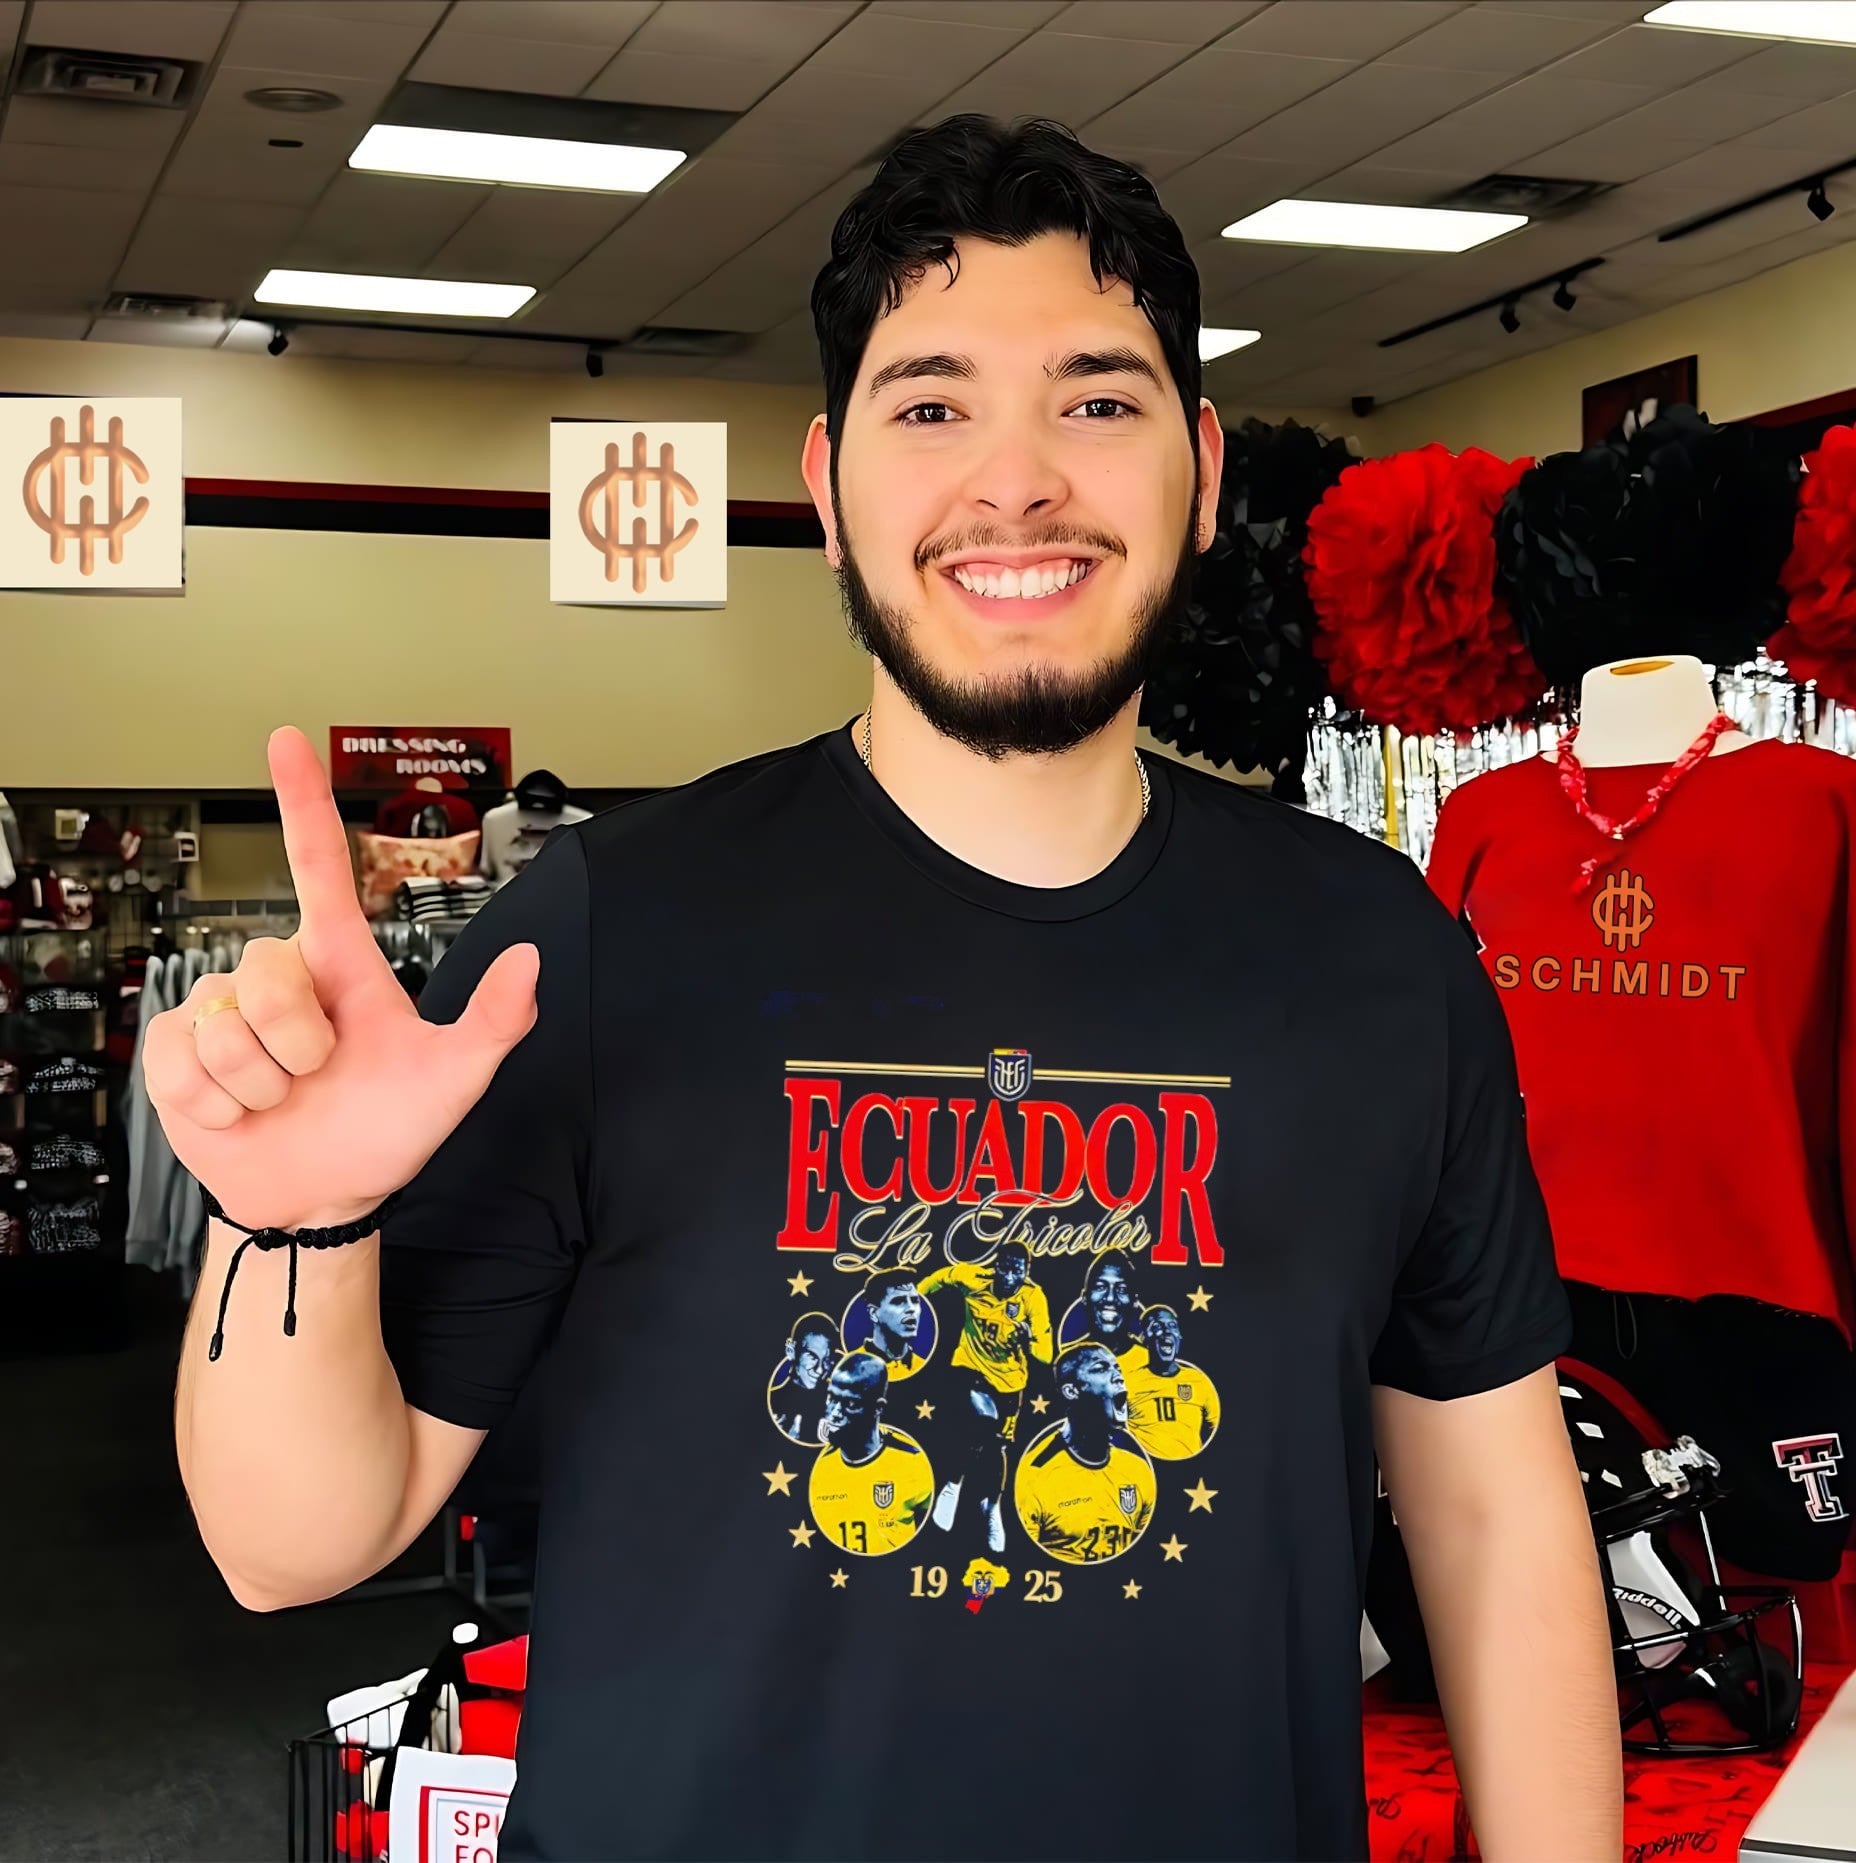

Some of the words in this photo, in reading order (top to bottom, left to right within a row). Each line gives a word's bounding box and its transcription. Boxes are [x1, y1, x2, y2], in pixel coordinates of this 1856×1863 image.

[342, 737, 467, 754] DRESSING
[396, 758, 487, 775] ROOMS
[1494, 954, 1747, 1000] SCHMIDT
[776, 1077, 1225, 1267] ECUADOR
[833, 1202, 932, 1274] La
[943, 1188, 1152, 1266] Tricolor
[1153, 1397, 1177, 1422] 10
[838, 1520, 868, 1553] 13
[910, 1565, 948, 1598] 19
[1023, 1569, 1063, 1602] 25
